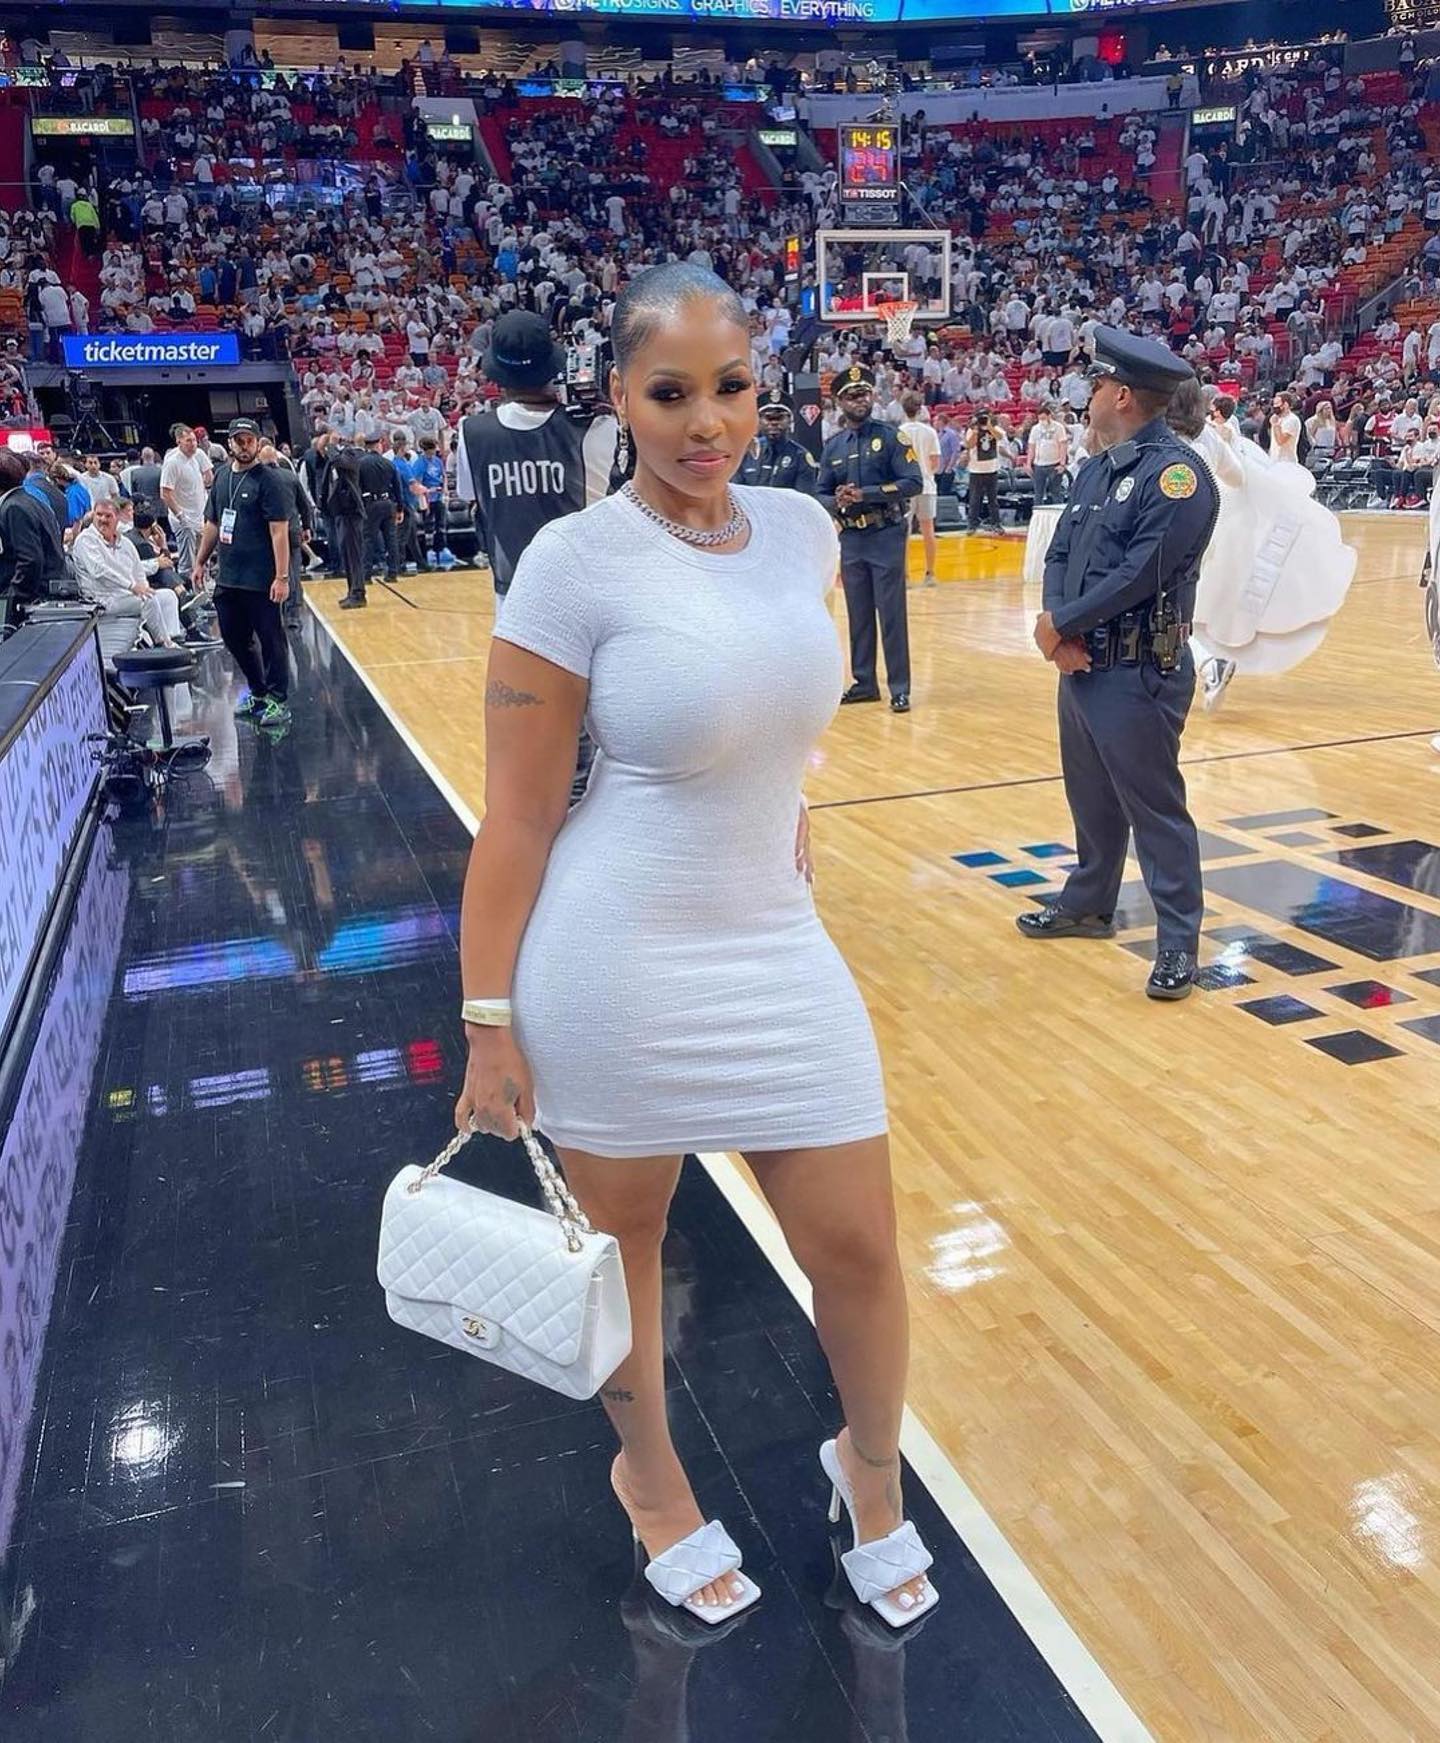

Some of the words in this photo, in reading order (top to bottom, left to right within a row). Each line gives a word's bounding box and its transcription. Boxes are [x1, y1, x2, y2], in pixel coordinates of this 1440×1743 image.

[859, 189, 897, 199] TISSOT
[84, 341, 219, 362] ticketmaster
[488, 460, 565, 499] PHOTO
